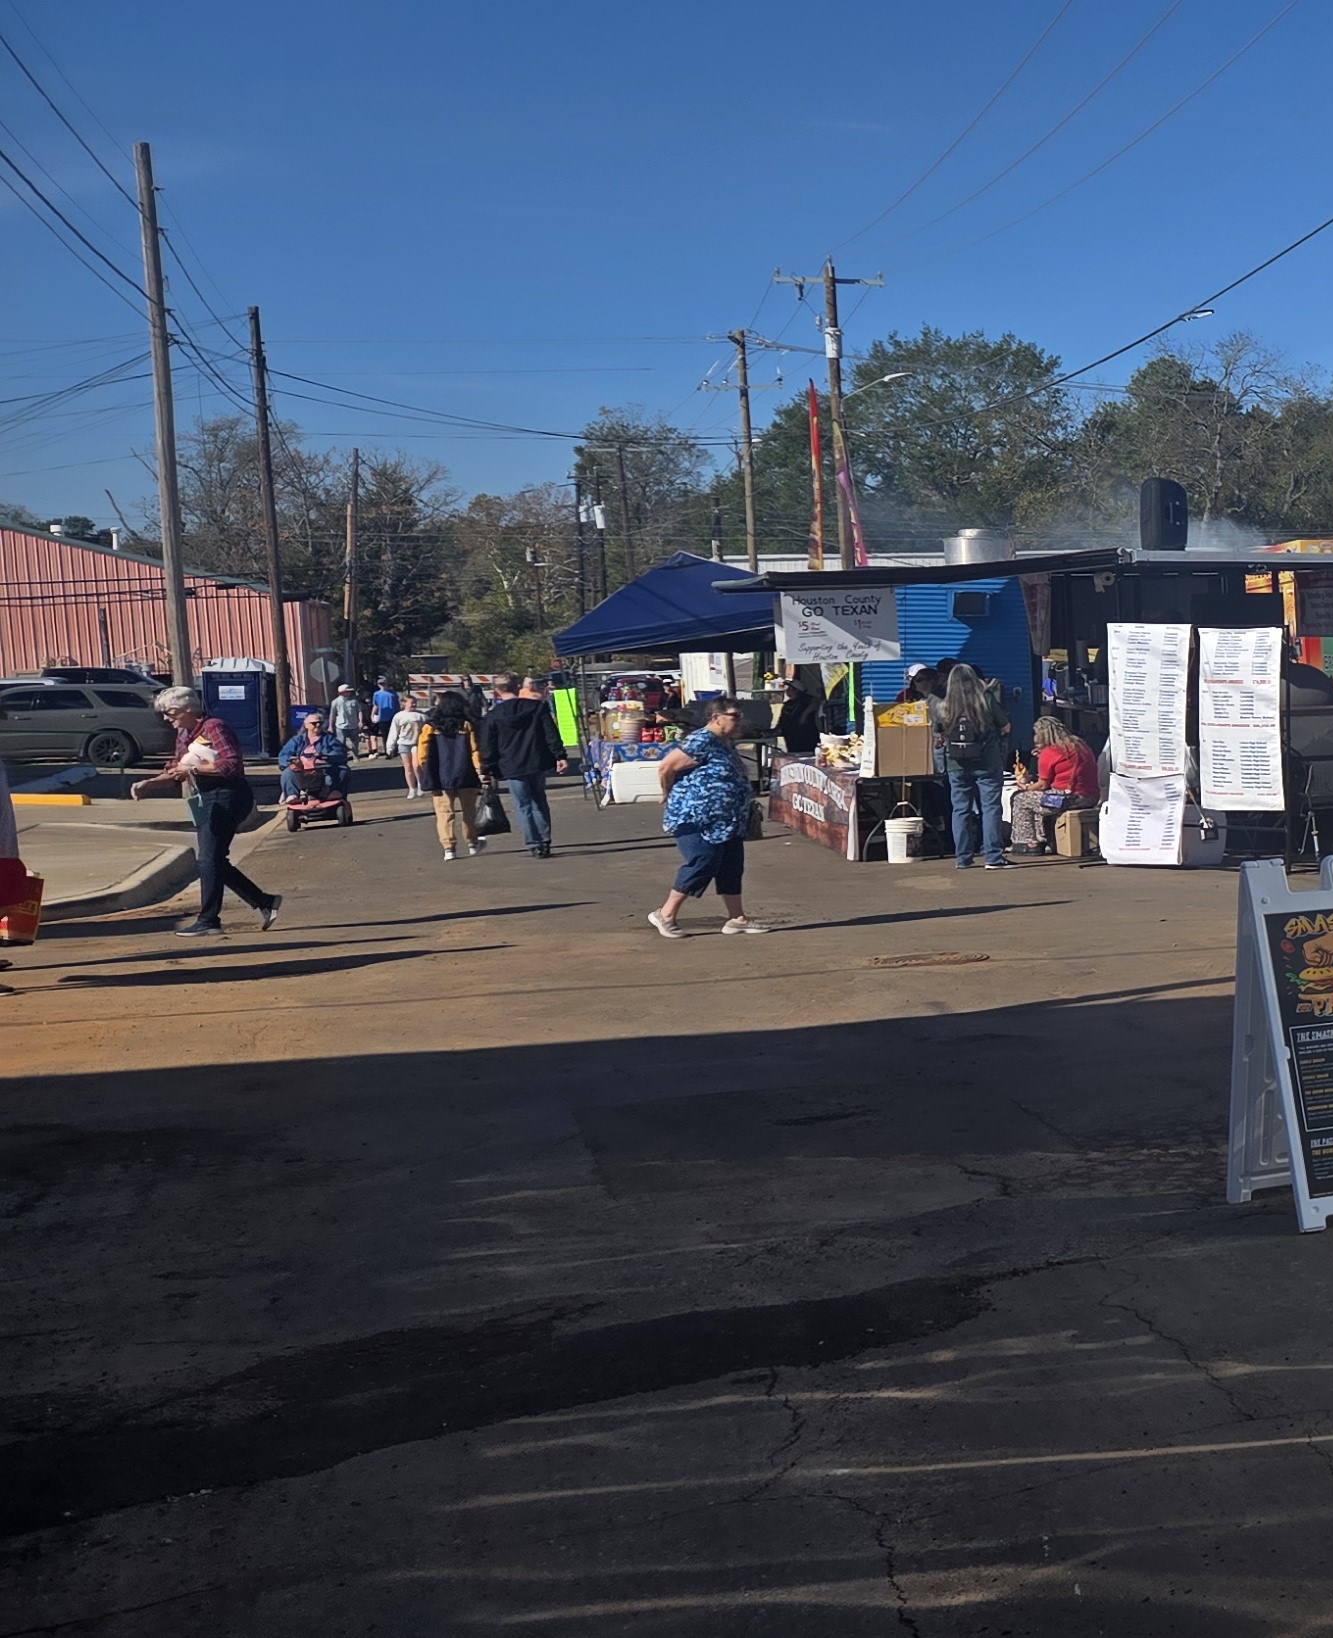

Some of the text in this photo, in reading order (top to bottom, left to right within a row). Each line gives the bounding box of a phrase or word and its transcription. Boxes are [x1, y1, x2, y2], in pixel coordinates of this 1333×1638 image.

[792, 594, 881, 606] Houston County
[802, 605, 878, 617] GO TEXAN
